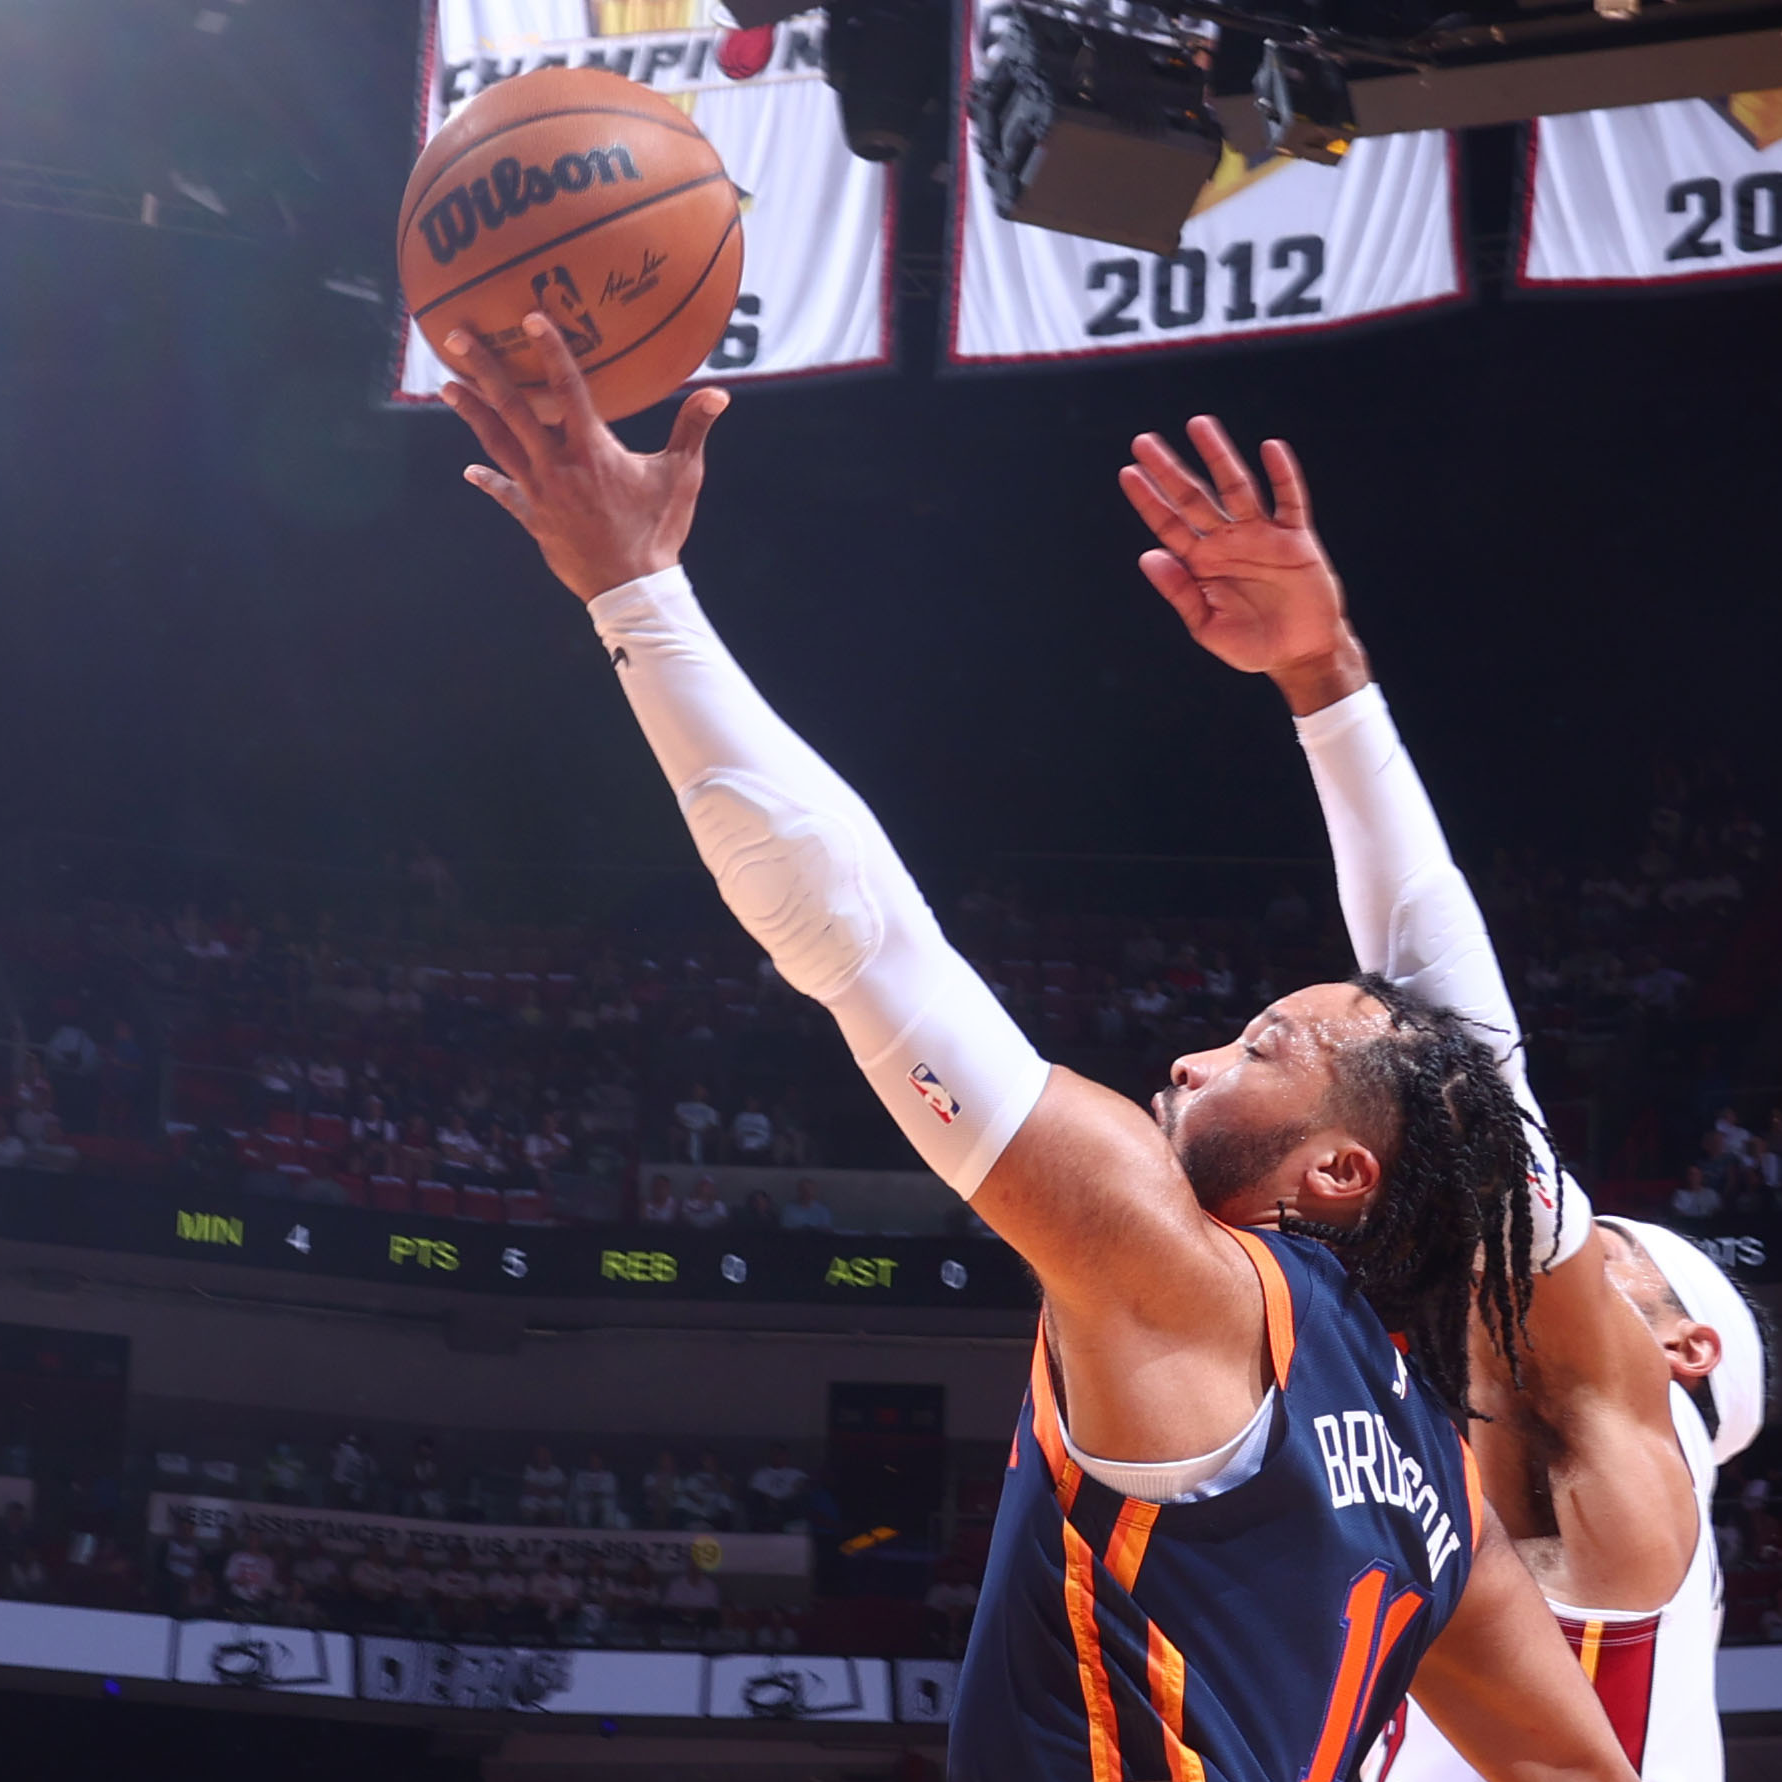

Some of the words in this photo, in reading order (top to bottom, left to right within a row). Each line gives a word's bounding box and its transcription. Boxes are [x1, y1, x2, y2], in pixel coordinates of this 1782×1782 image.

[418, 139, 643, 266] Wilson
[1084, 234, 1326, 337] 2012
[175, 1210, 244, 1248] MIN
[285, 1223, 312, 1254] 4
[389, 1234, 461, 1272] PTS
[501, 1247, 528, 1279] 5
[600, 1249, 678, 1285] REB
[824, 1255, 899, 1289] AST
